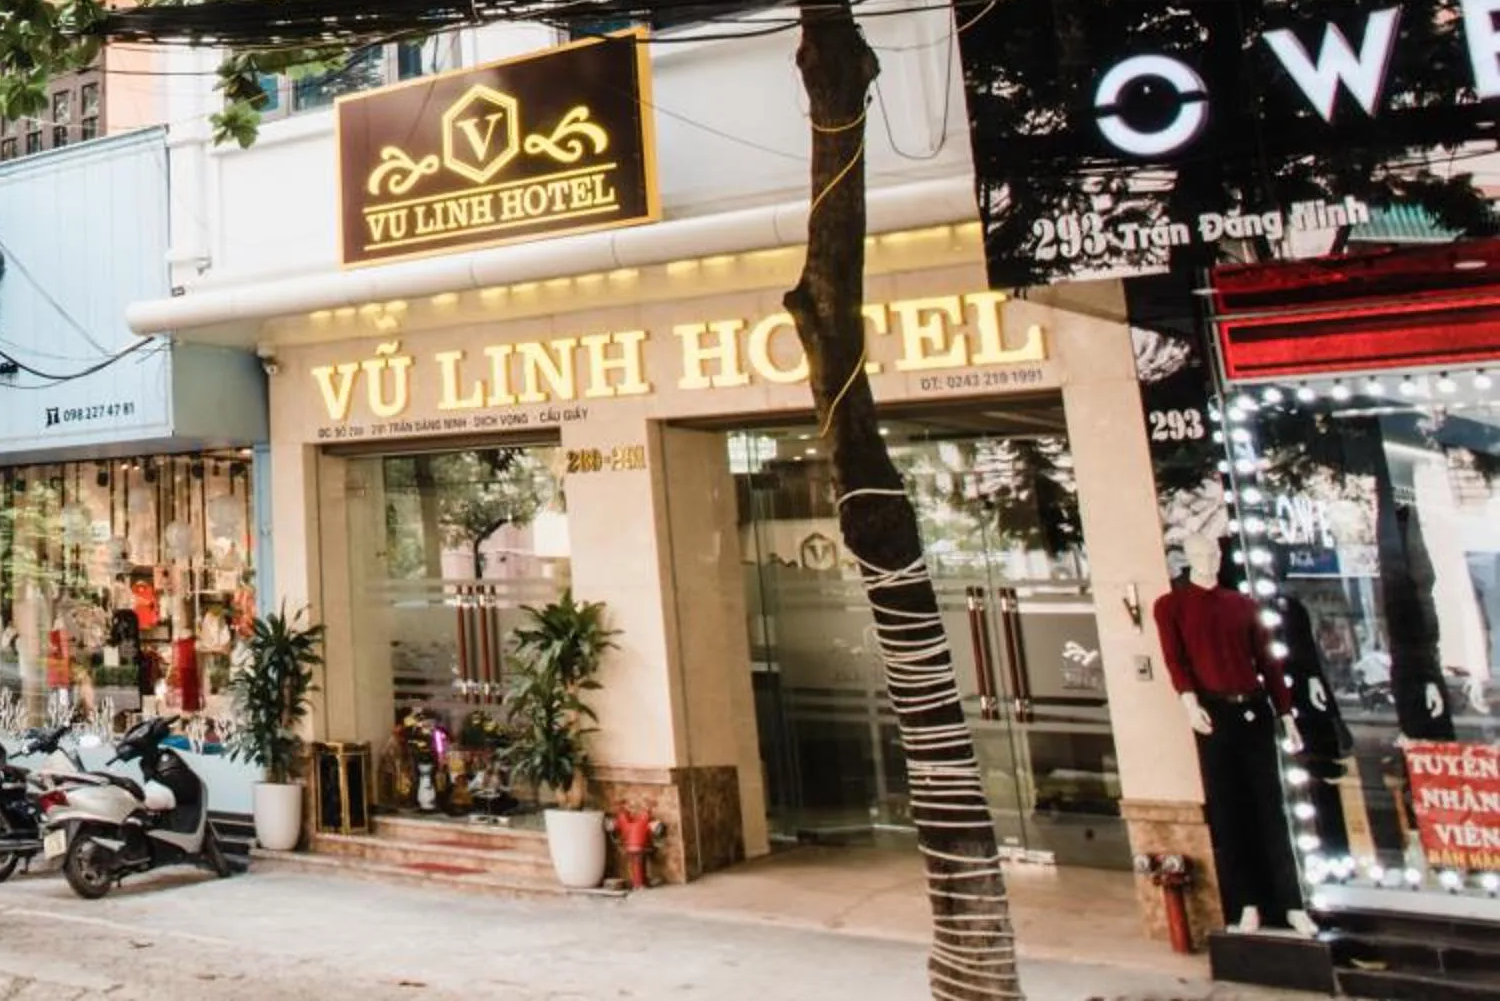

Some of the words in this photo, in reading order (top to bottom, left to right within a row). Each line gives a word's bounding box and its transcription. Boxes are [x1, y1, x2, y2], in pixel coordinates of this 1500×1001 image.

[456, 112, 503, 162] V
[414, 193, 494, 235] LINH
[501, 173, 616, 221] HOTEL
[1032, 209, 1109, 260] 293
[311, 339, 416, 421] VŨ
[435, 330, 655, 411] LINH
[1149, 407, 1205, 441] 293
